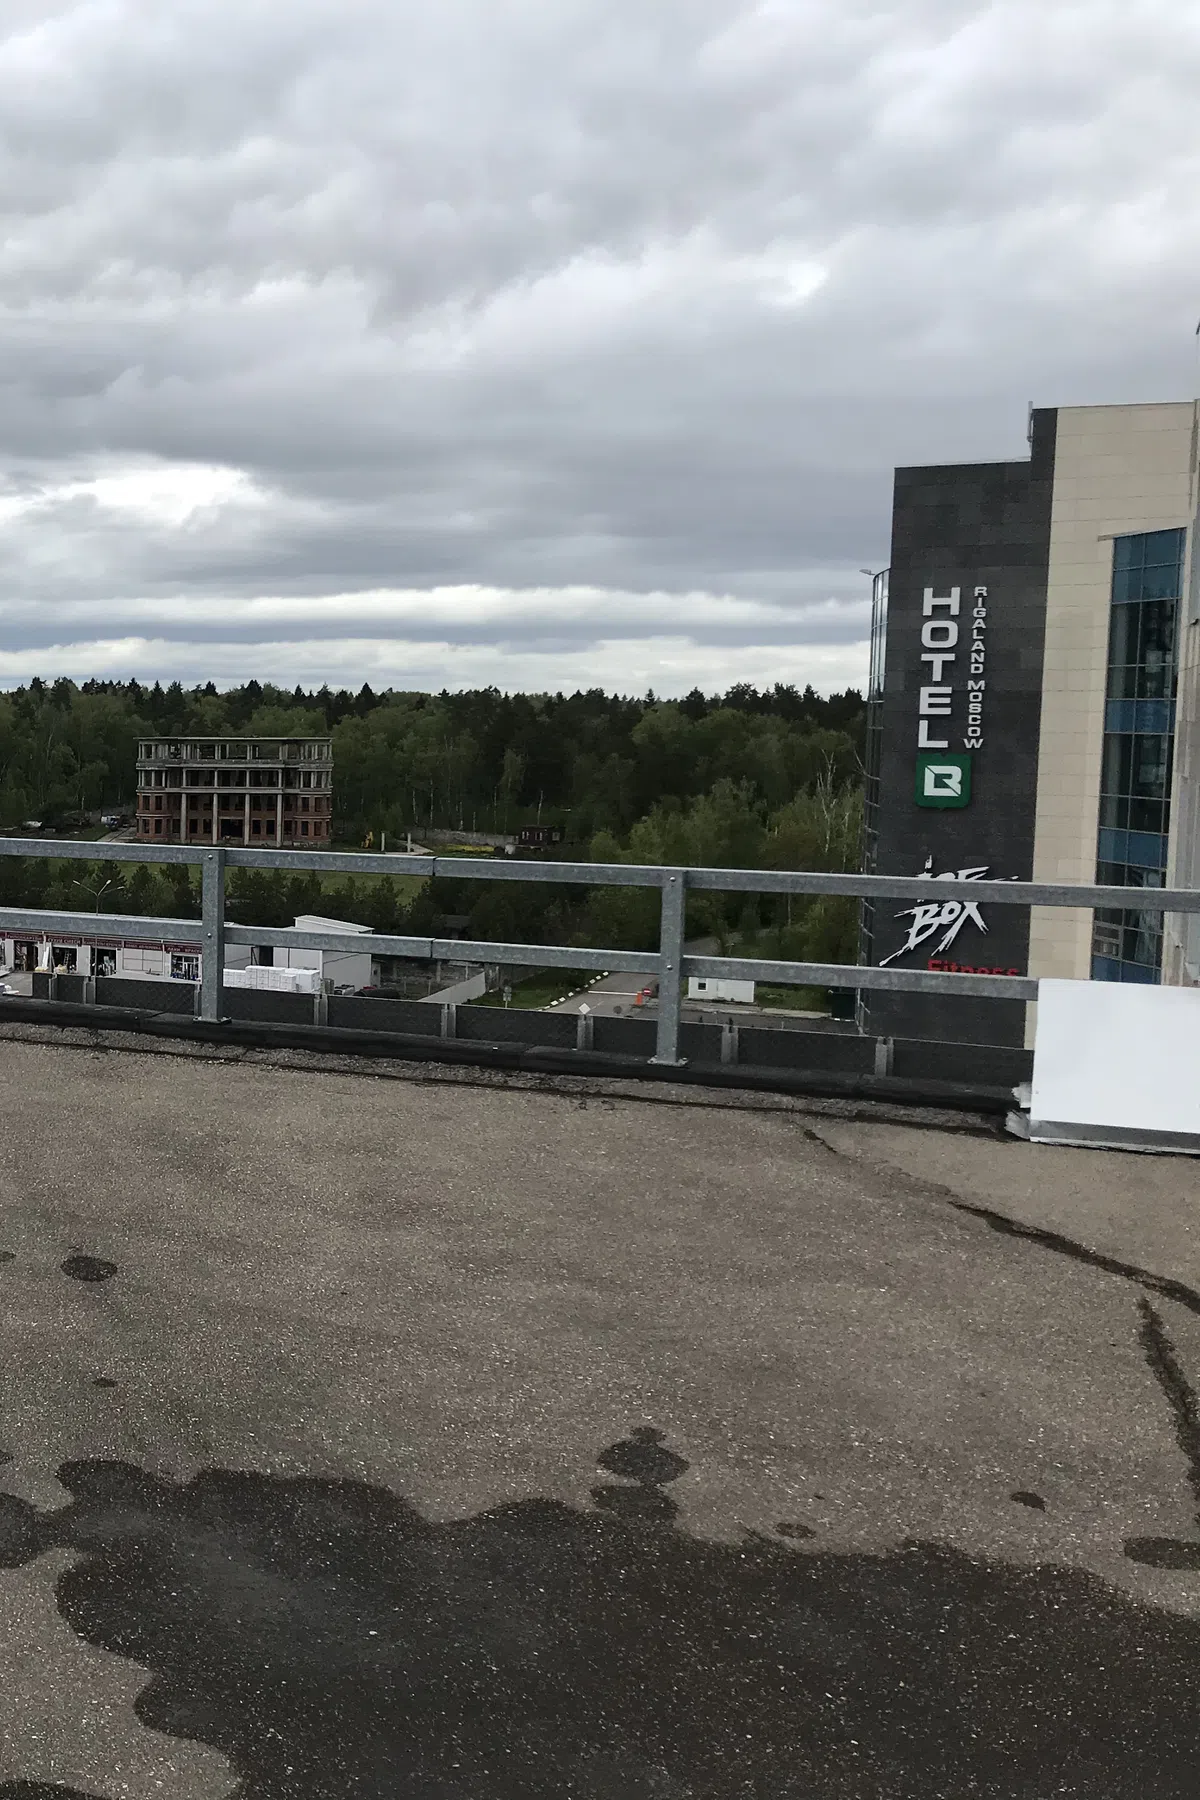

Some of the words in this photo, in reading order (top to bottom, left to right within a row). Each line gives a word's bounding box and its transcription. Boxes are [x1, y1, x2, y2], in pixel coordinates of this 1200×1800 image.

[917, 586, 961, 749] HOTEL
[971, 586, 988, 674] RIGALAND
[963, 680, 986, 749] MOSCOW
